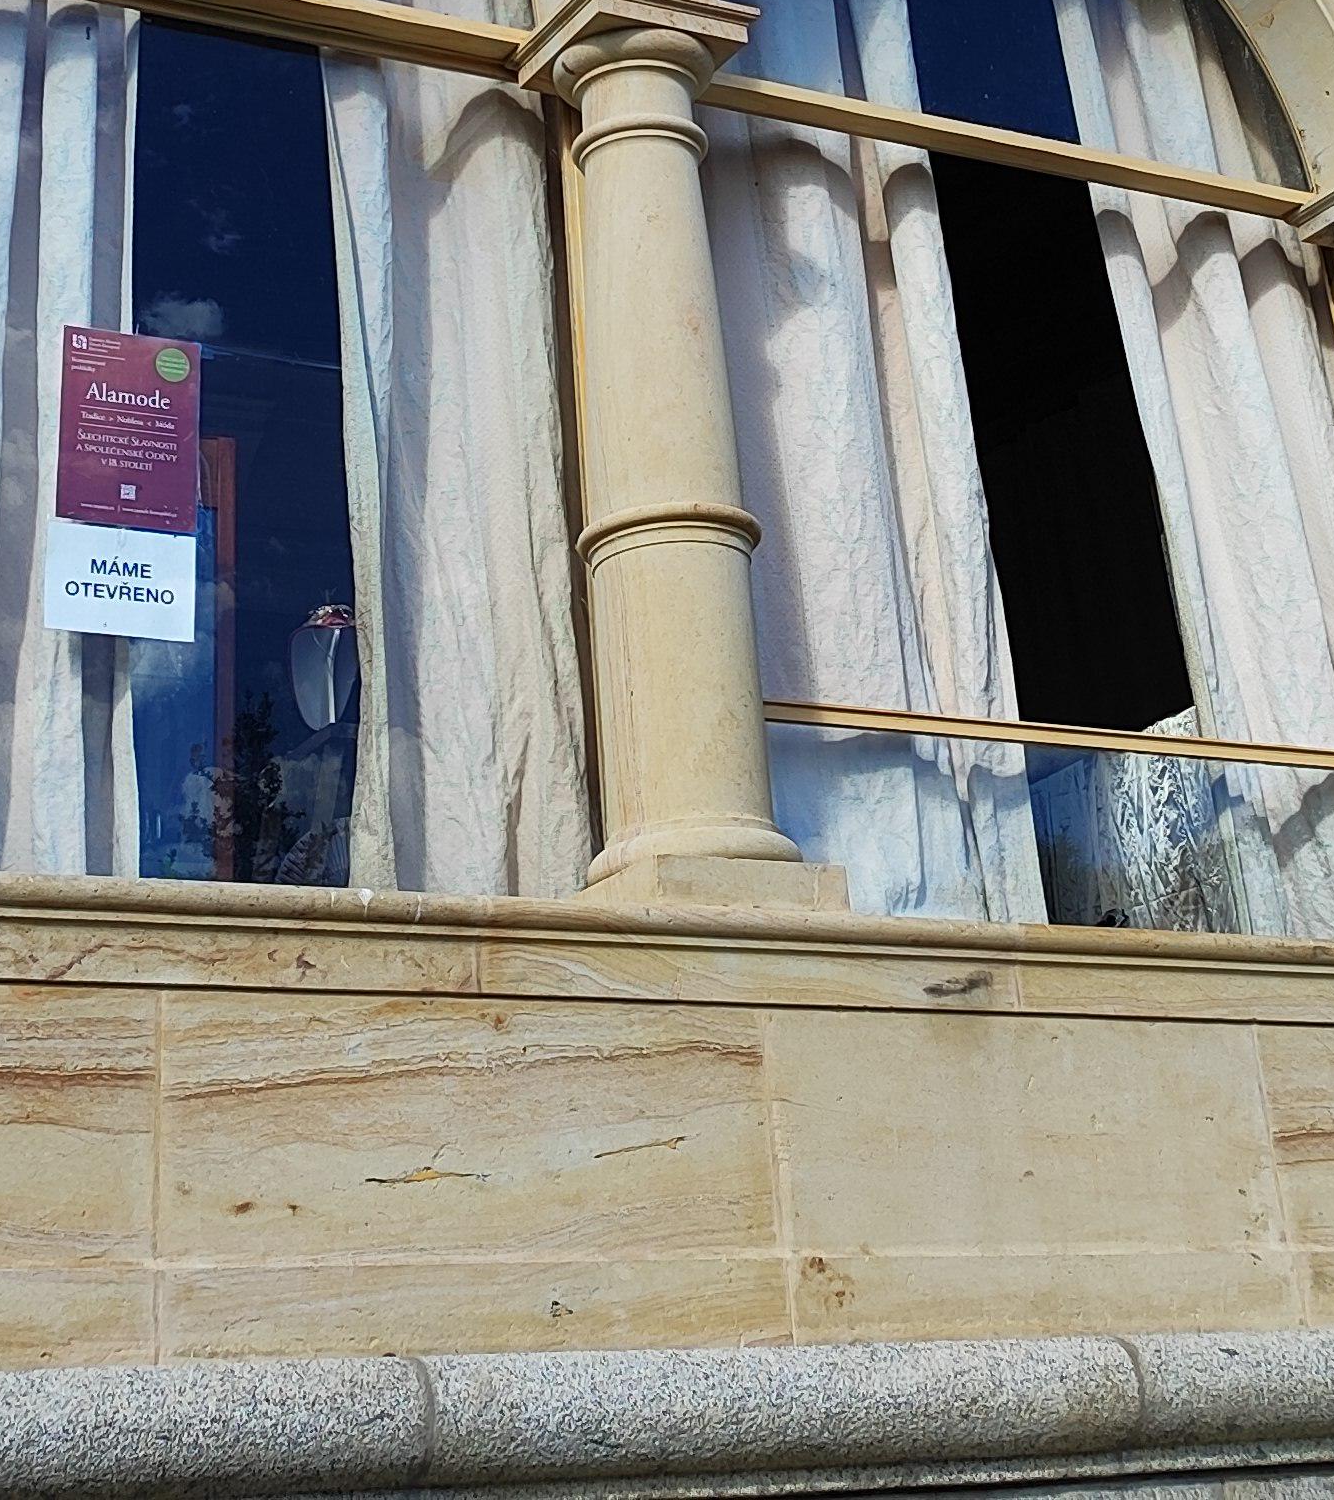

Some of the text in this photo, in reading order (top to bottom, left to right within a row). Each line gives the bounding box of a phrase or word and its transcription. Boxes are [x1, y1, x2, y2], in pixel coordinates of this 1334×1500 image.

[85, 382, 171, 410] Alamode
[90, 556, 152, 579] MÁME
[65, 581, 174, 605] OTEVŘENO
